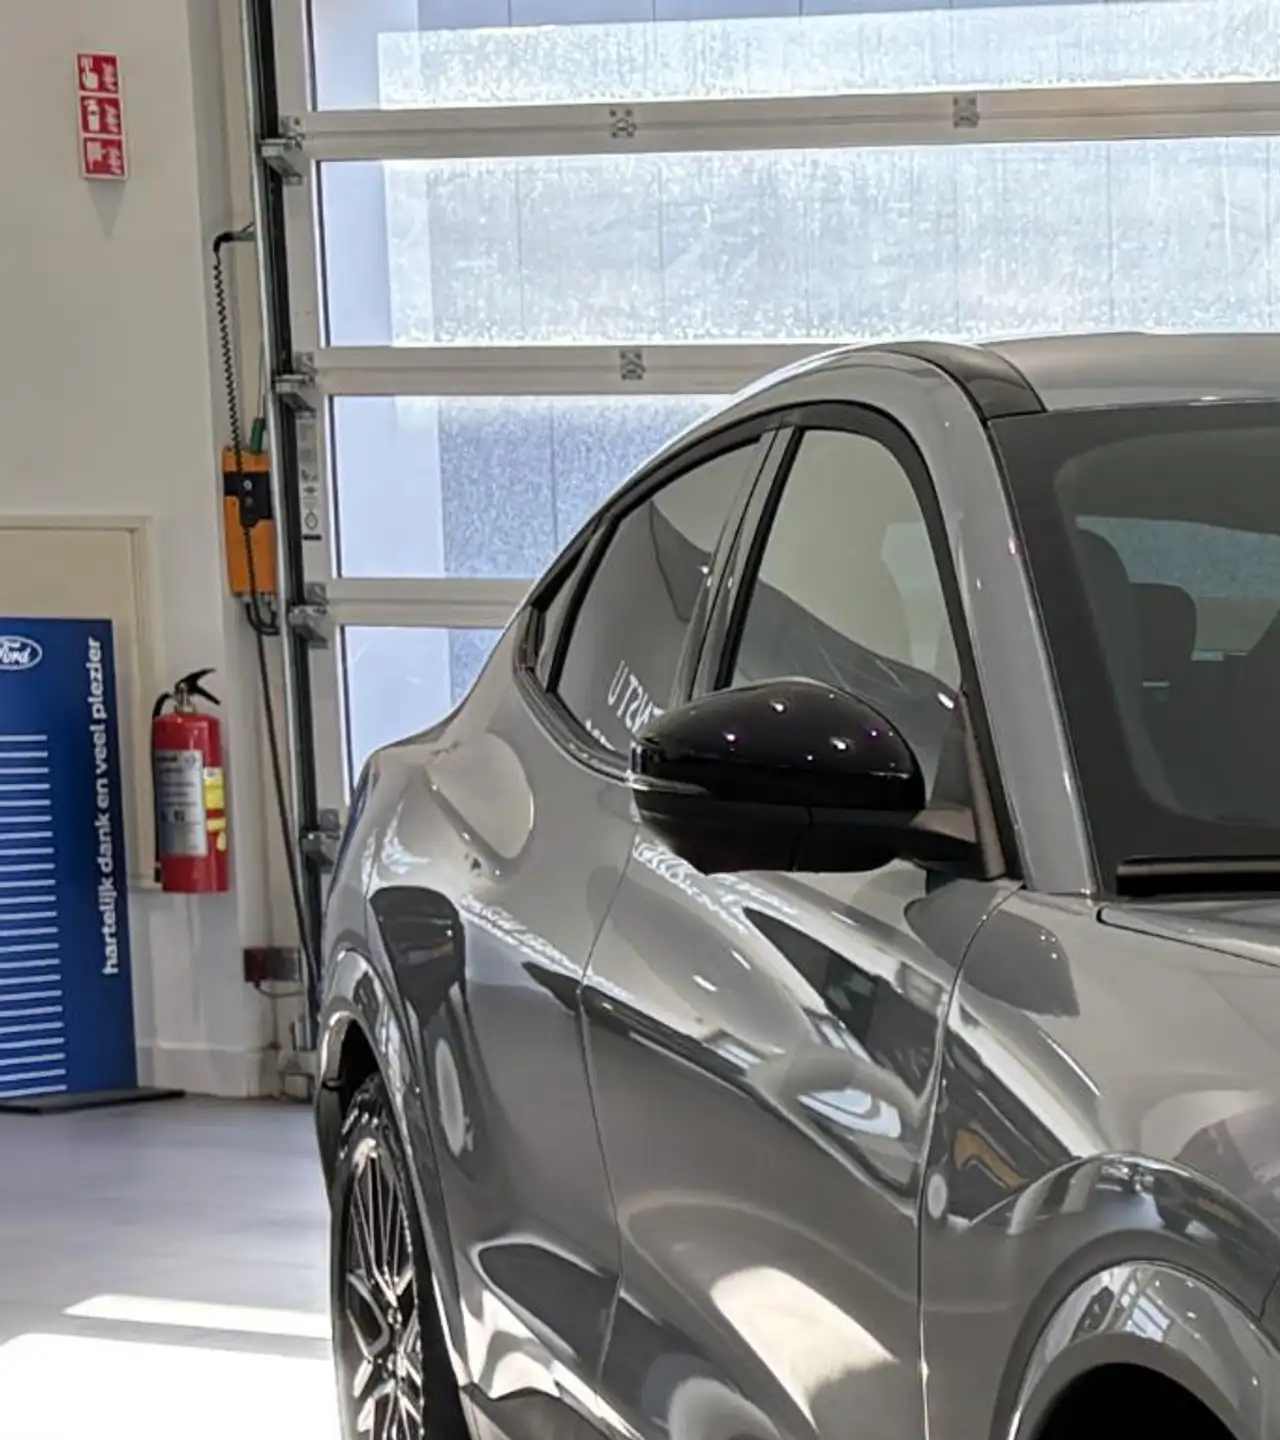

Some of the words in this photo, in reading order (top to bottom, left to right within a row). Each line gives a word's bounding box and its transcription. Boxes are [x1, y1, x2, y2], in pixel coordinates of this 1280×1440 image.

[85, 636, 108, 719] plezier
[89, 723, 108, 775] veel
[96, 777, 110, 809] en
[94, 812, 114, 873] dank
[98, 875, 119, 975] hartelijk
